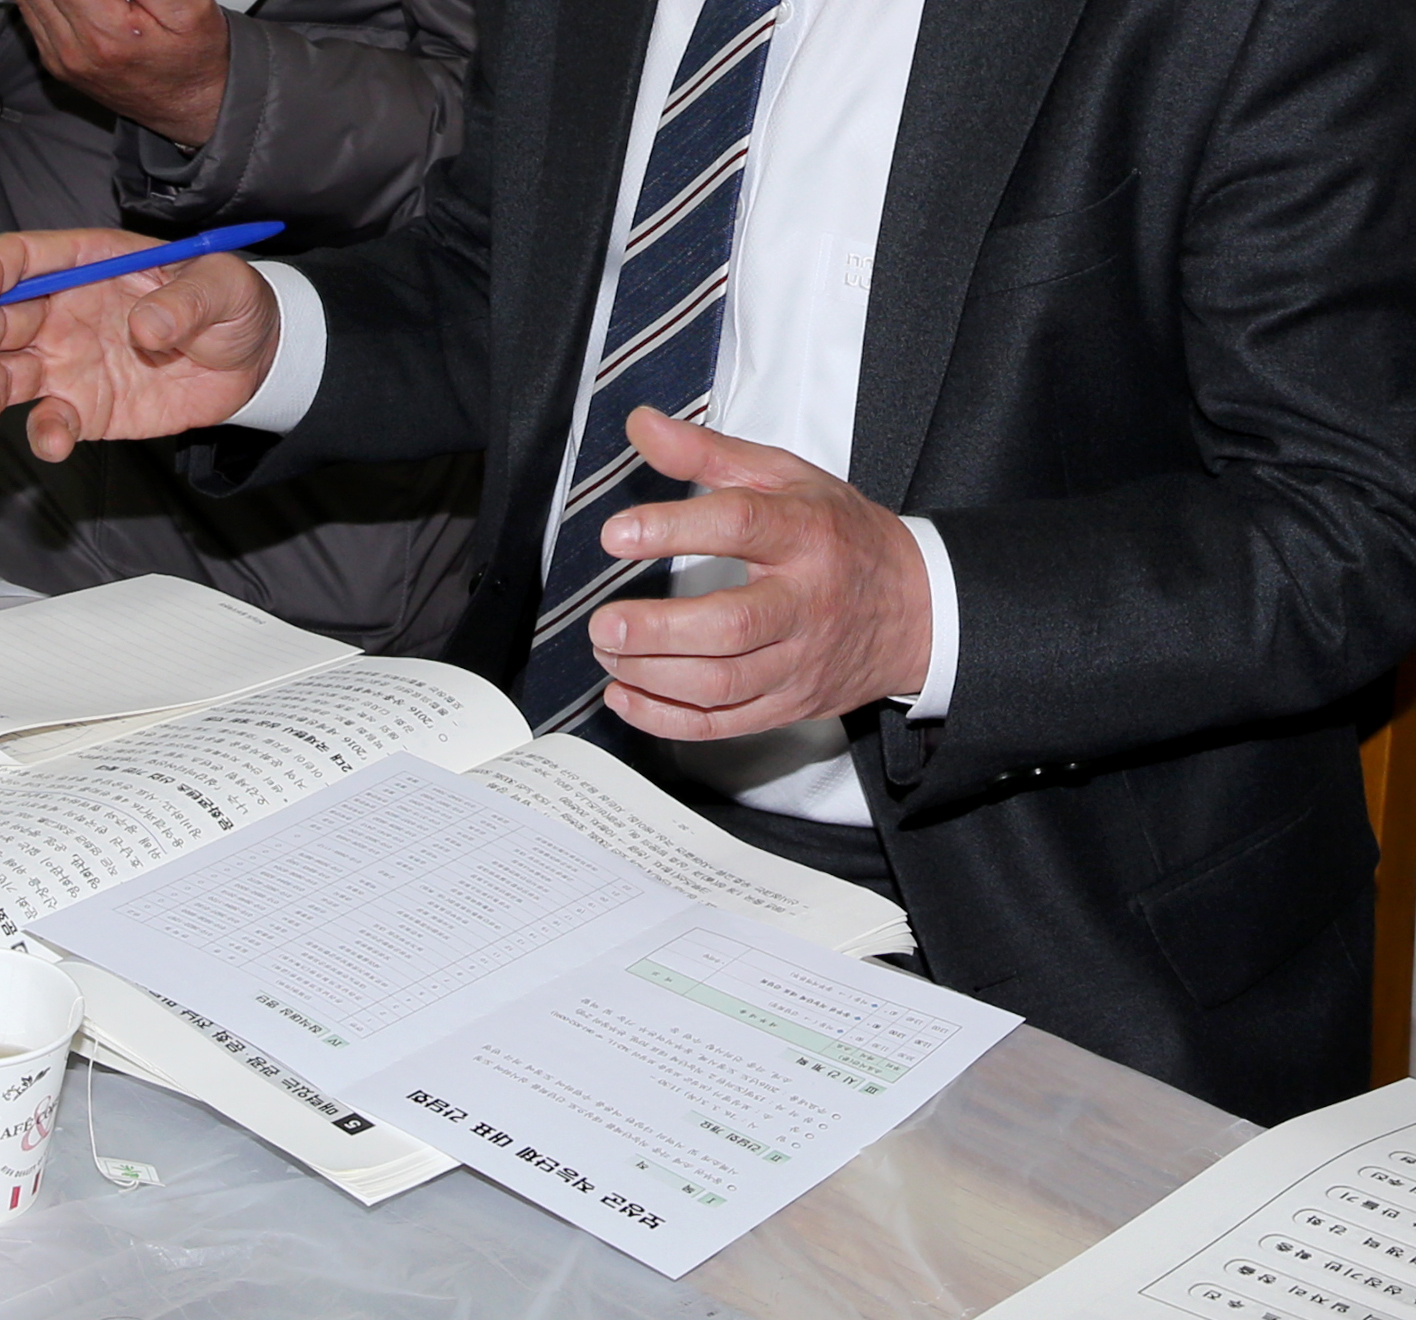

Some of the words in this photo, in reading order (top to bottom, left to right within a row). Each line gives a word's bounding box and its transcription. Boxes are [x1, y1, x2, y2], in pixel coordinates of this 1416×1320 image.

[281, 727, 329, 753] 국제행사
[330, 753, 353, 773] 2대
[147, 771, 175, 784] 산업
[177, 783, 233, 831] 문화콘텐츠
[251, 994, 281, 1009] 명단
[179, 1009, 214, 1030] 전남
[275, 1007, 327, 1034] 참석대상
[281, 1076, 338, 1117] 매력있는
[404, 1088, 471, 1124] 간담회
[344, 1118, 363, 1130] 5
[466, 1120, 517, 1148] 대표
[696, 1119, 726, 1134] 개요
[722, 1131, 764, 1152] 간담회
[512, 1145, 603, 1194] 직능단체
[1370, 1170, 1405, 1188] 추진
[596, 1190, 668, 1230] 보성군
[1339, 1191, 1400, 1219] 만들기
[1305, 1213, 1347, 1237] 강화
[1274, 1241, 1313, 1262] 확충
[1237, 1264, 1277, 1286] 창출
[1323, 1260, 1402, 1297] 성장기반
[1201, 1290, 1246, 1310] 추진
[1287, 1284, 1350, 1314] 일자리
